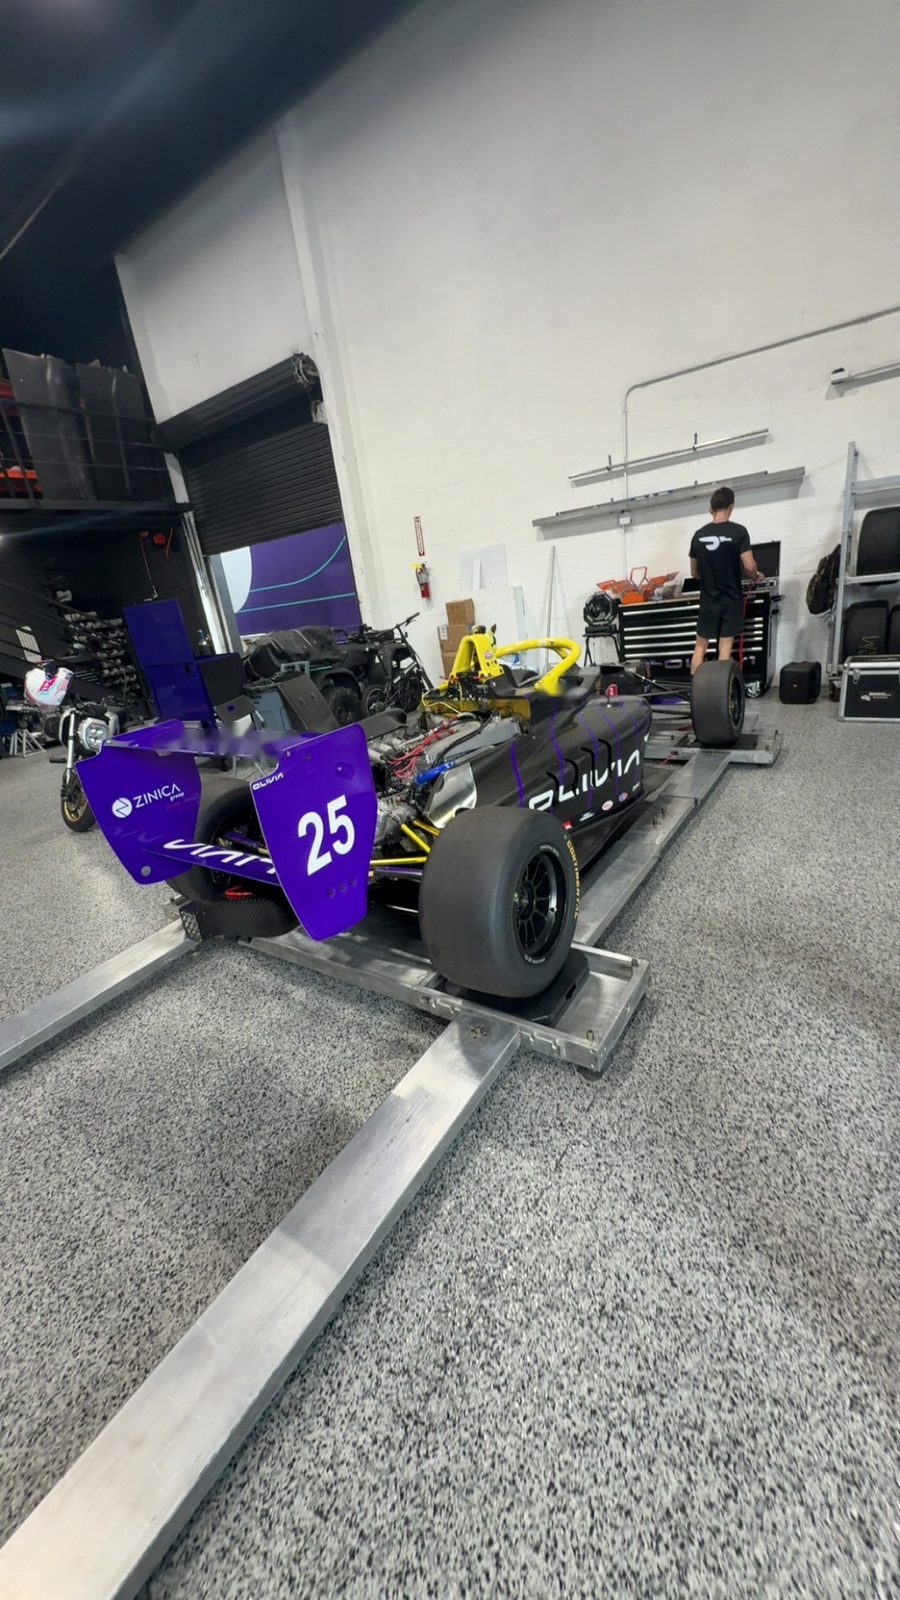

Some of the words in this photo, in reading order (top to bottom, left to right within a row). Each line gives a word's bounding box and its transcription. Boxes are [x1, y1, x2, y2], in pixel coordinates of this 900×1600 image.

[252, 772, 284, 791] OLIVIA
[133, 783, 181, 809] ZINICA
[297, 795, 356, 876] 25
